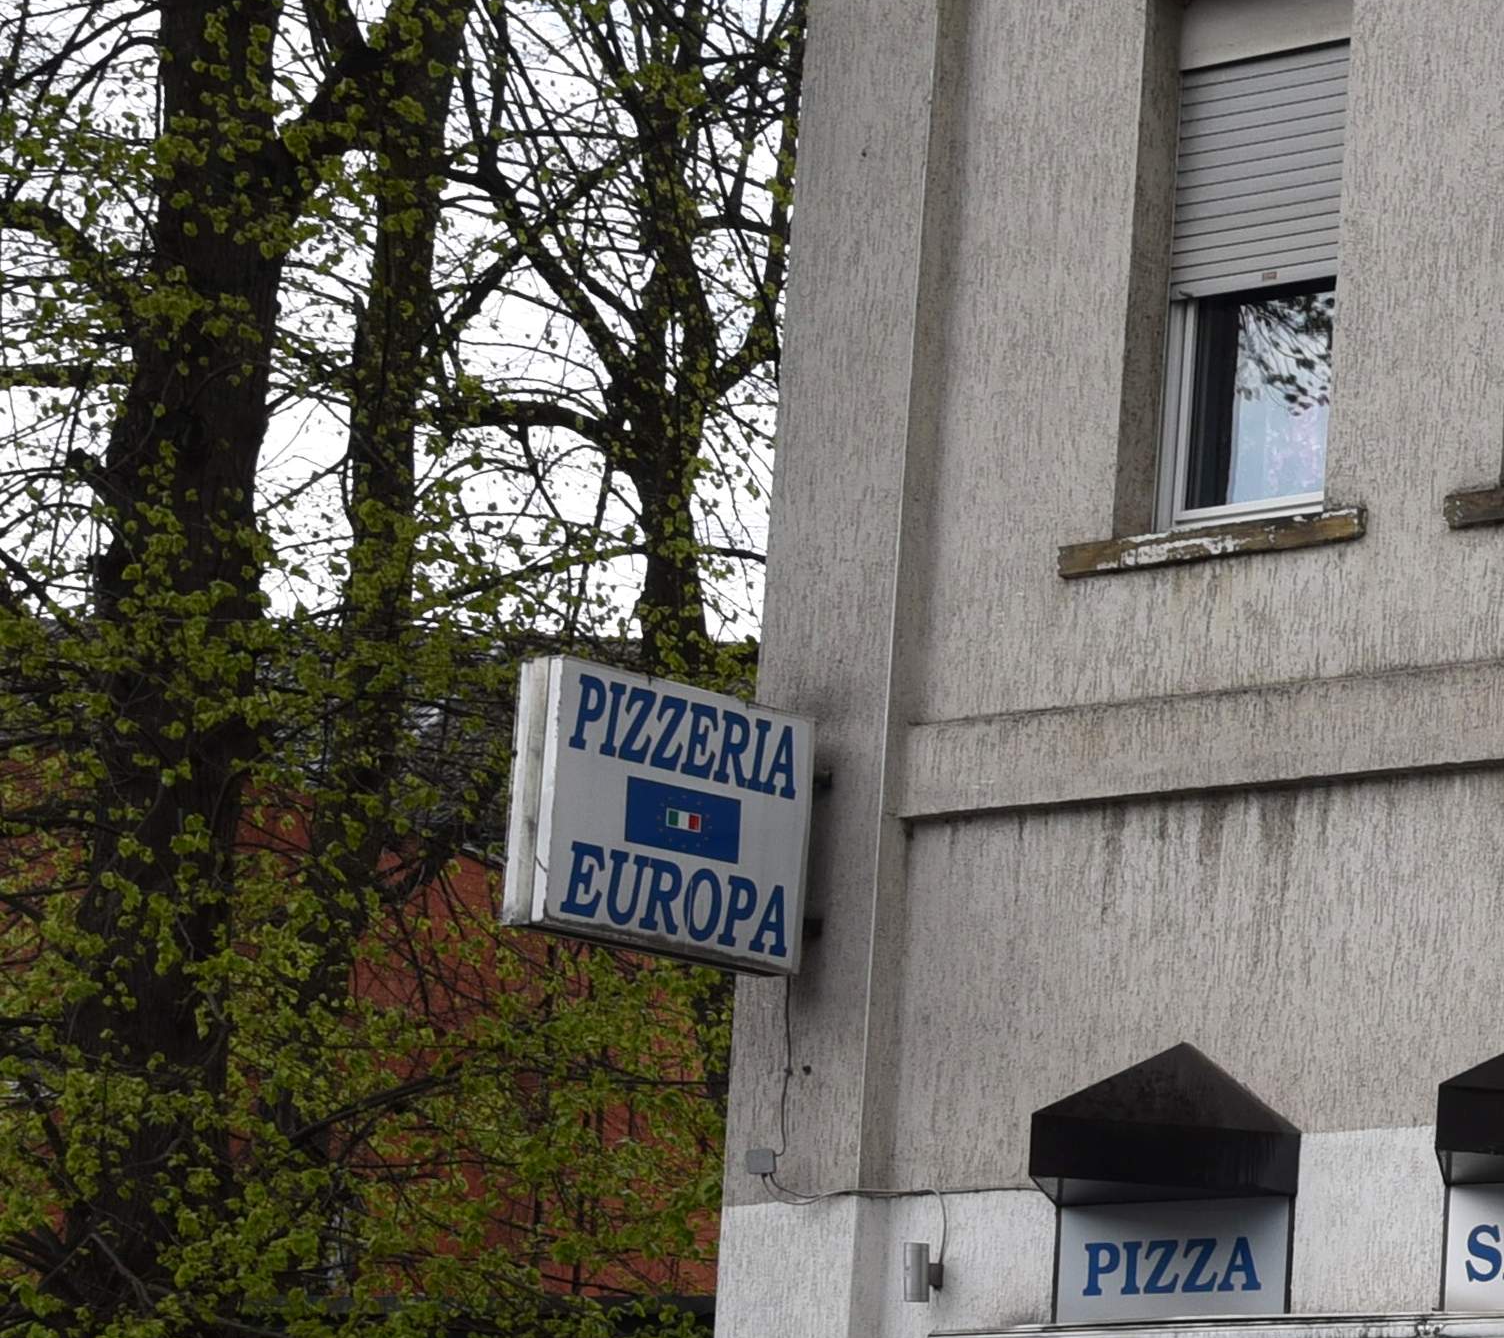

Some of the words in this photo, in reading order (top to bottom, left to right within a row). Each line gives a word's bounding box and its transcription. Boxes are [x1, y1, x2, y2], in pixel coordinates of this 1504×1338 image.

[568, 673, 796, 801] PIZZERIA
[559, 840, 787, 958] EUROPA
[1082, 1235, 1262, 1297] PIZZA
